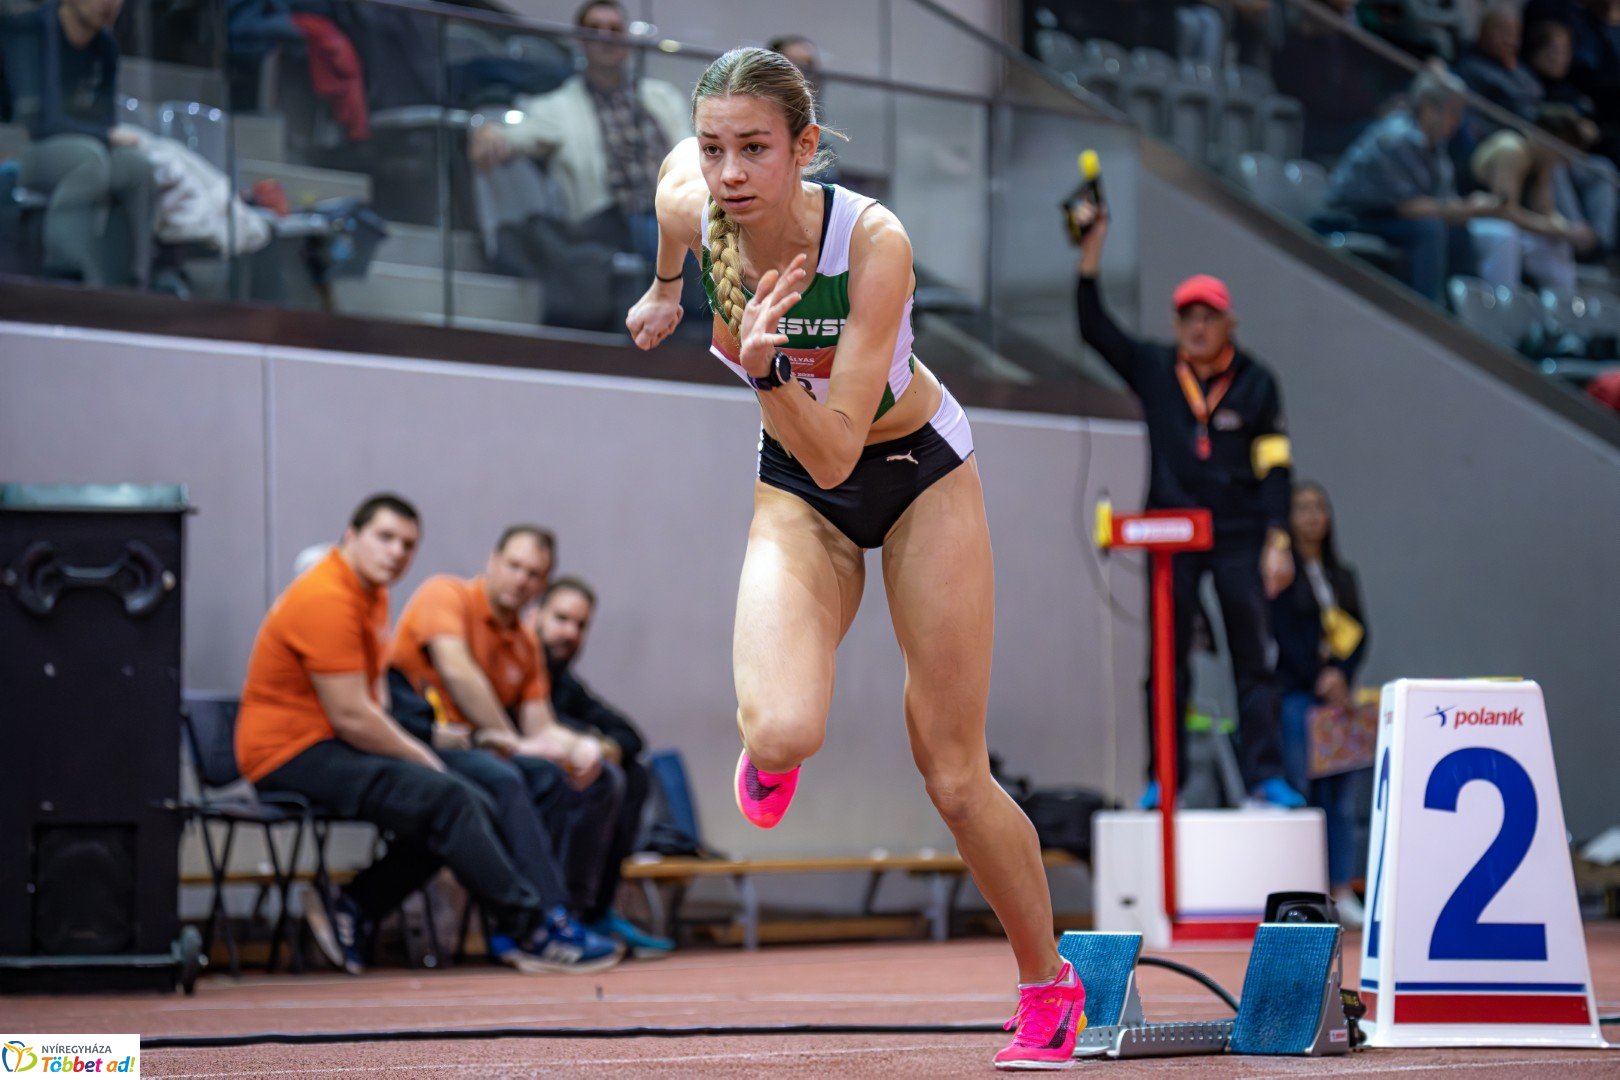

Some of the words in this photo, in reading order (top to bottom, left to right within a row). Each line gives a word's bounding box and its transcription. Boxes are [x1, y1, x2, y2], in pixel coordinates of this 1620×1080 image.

[1454, 706, 1524, 730] polanik
[1367, 746, 1390, 958] 2
[1423, 746, 1549, 962] 2
